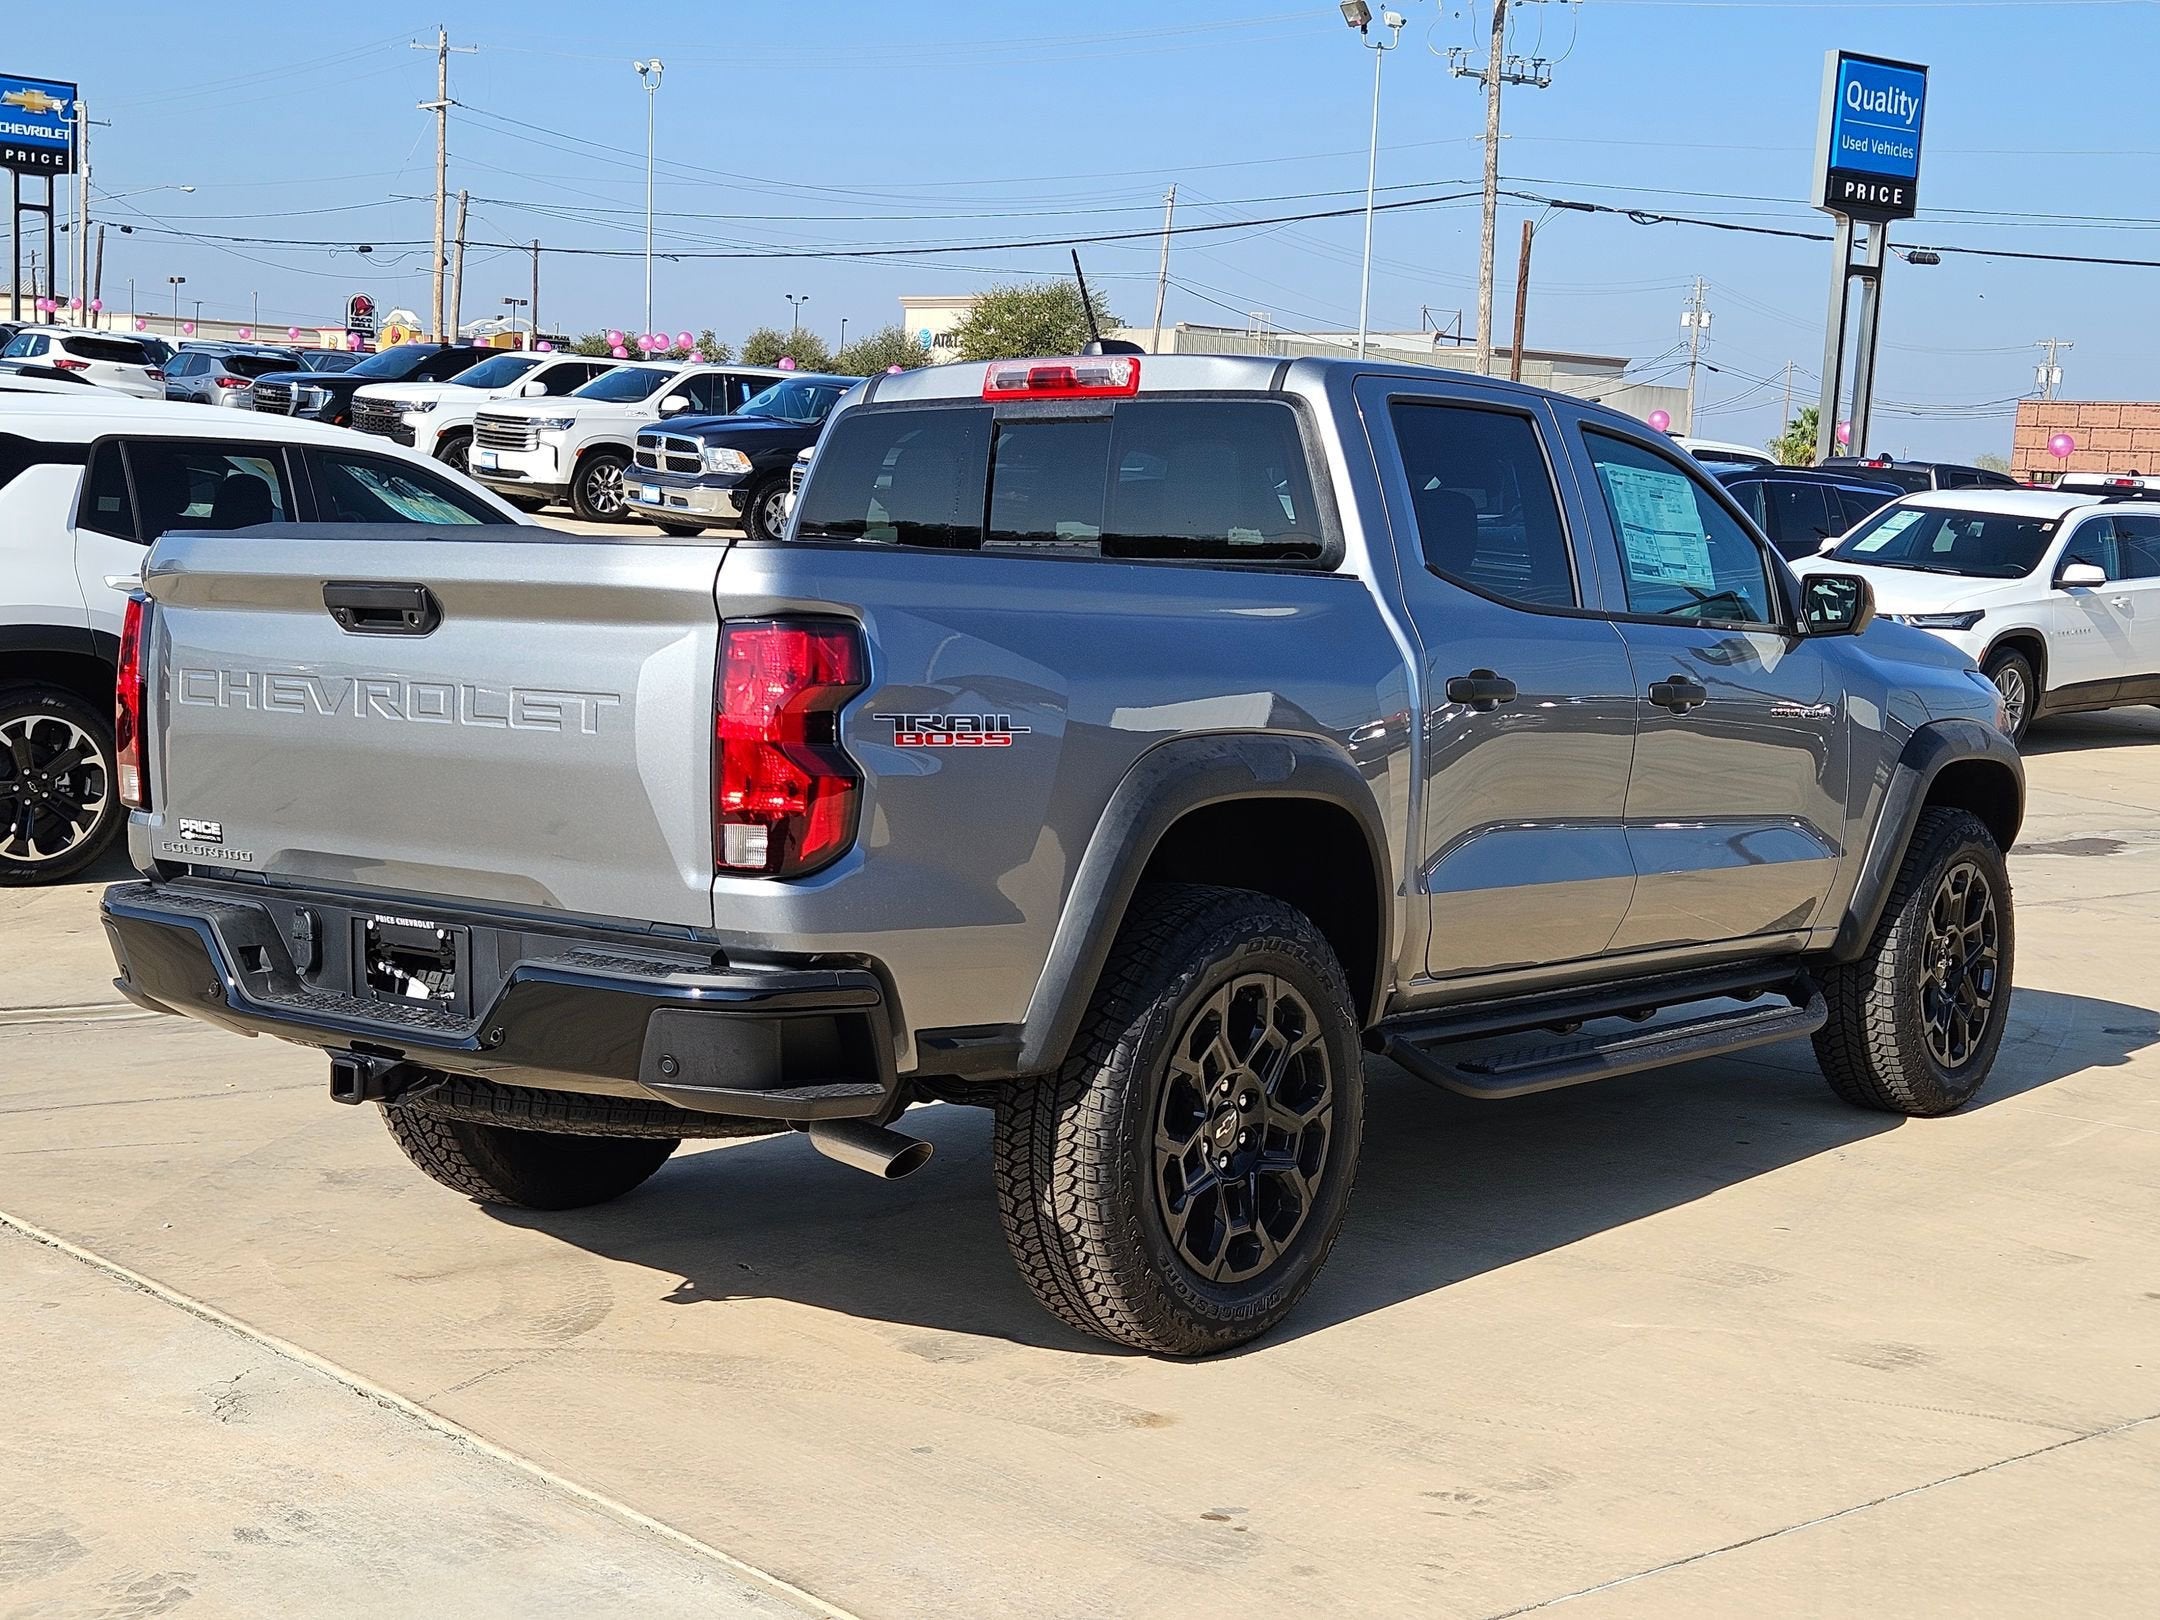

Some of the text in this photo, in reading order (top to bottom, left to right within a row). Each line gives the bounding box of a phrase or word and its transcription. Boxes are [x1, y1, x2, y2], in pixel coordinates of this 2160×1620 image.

[1847, 80, 1919, 125] Quality
[0, 121, 70, 140] CHEVROLET
[1842, 134, 1914, 159] Used Vehicles
[5, 149, 64, 166] PRICE
[1845, 181, 1903, 205] PRICE
[932, 333, 960, 348] AT&T
[178, 667, 621, 734] CHEVROLET
[873, 714, 1032, 733] TRAIL
[894, 731, 1013, 747] BOSS
[179, 818, 221, 835] PRICE
[162, 841, 253, 862] COLORADO
[375, 914, 435, 930] PRICE CHEVROLET
[1157, 1254, 1284, 1322] BRIDGESTONE
